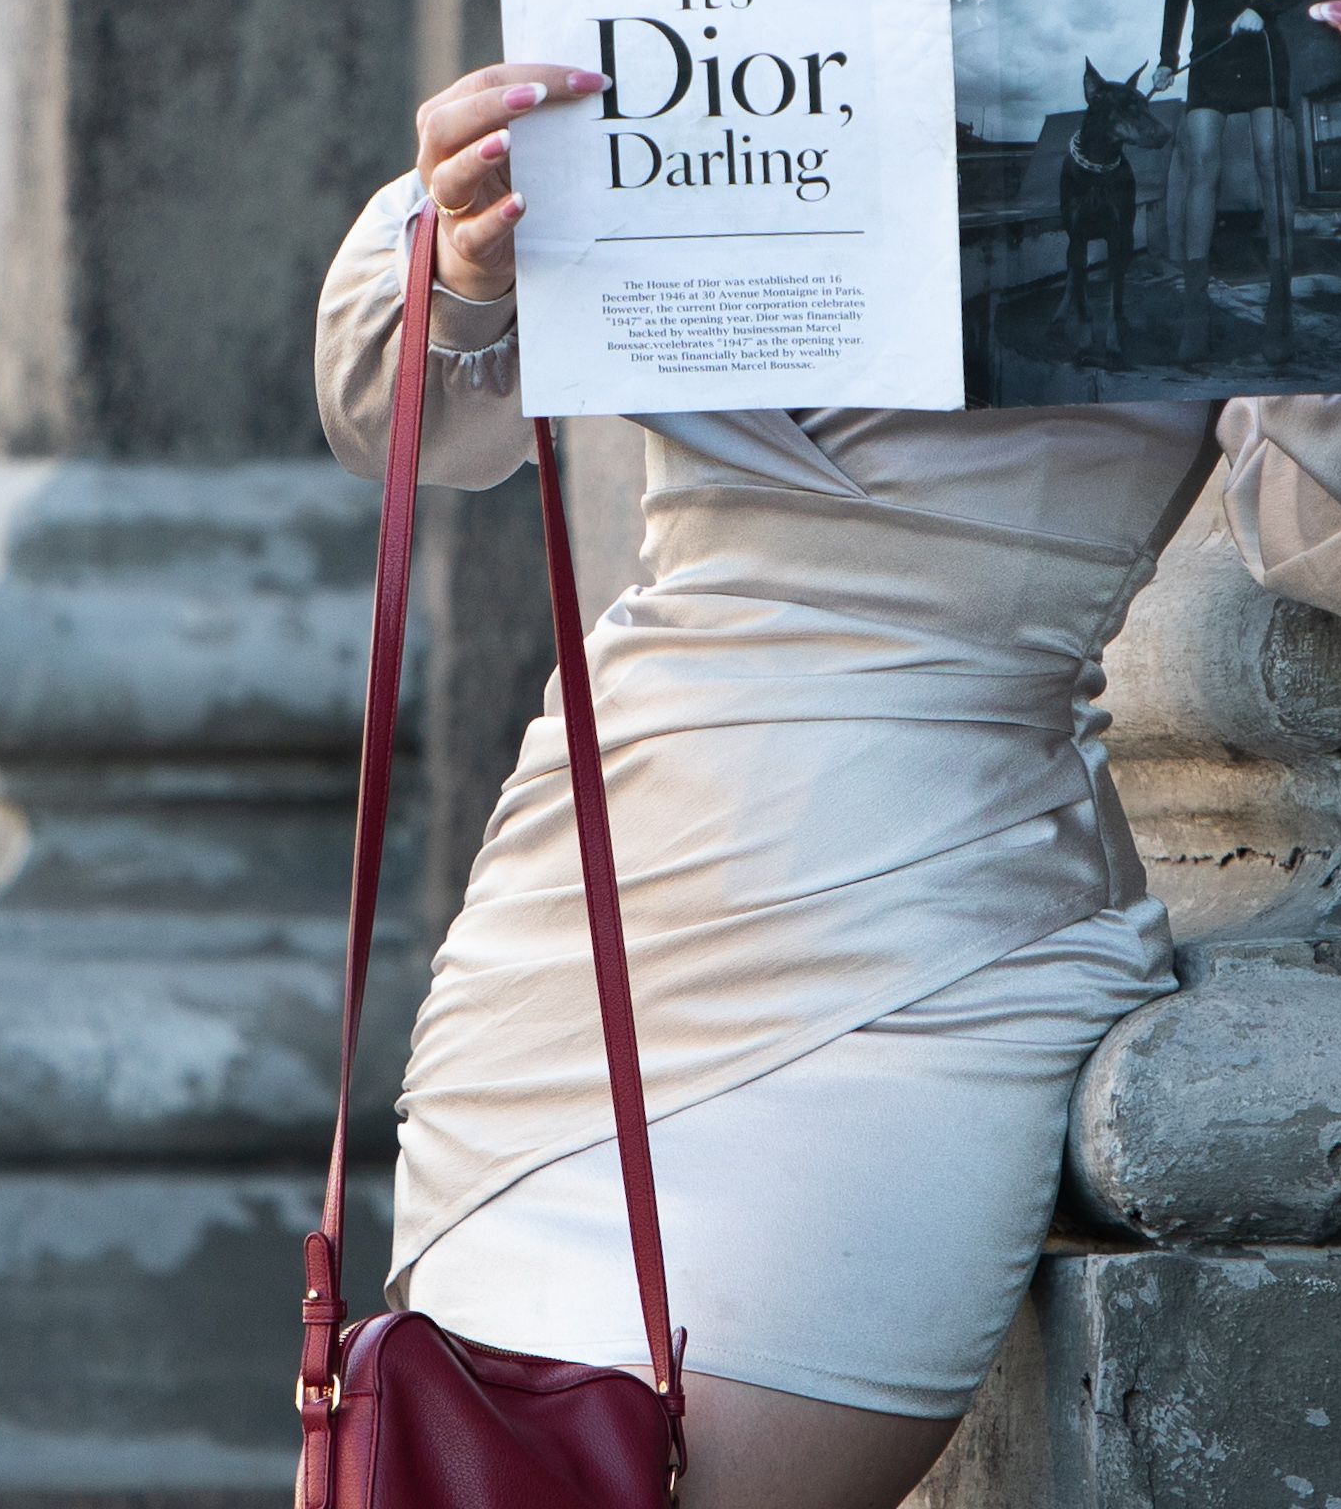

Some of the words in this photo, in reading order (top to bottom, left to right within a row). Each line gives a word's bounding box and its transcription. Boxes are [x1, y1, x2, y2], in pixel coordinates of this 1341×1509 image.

[586, 17, 853, 128] Dior,
[603, 129, 831, 202] Darling
[623, 280, 644, 290] The
[647, 280, 680, 289] House
[683, 279, 694, 288] of
[698, 278, 721, 288] Dior
[724, 279, 745, 287] was
[748, 275, 808, 286] established
[830, 275, 842, 284] 16
[602, 293, 656, 303] December
[660, 291, 686, 301] 1946
[688, 291, 698, 300] at
[702, 290, 715, 300] 30
[718, 291, 760, 299] Avenue
[763, 287, 818, 298] Montaigne
[822, 286, 832, 296] in
[836, 286, 864, 296] Paris.
[603, 305, 653, 315] However,
[656, 303, 673, 313] the
[677, 303, 716, 314] current
[719, 301, 743, 311] Dior
[746, 300, 808, 311] corporation
[811, 298, 865, 308] celebrates
[645, 318, 657, 326] as
[660, 315, 677, 326] the
[680, 315, 724, 326] opening
[756, 312, 780, 322] Dior
[783, 313, 803, 321] was
[807, 310, 863, 321] financially
[629, 327, 667, 338] backed
[668, 327, 684, 339] by
[687, 326, 730, 337] wealthy
[733, 325, 802, 335] businessman
[806, 323, 841, 333] Marcel
[756, 338, 768, 346] as
[771, 336, 788, 346] the
[791, 336, 834, 347] opening
[631, 352, 654, 362] Dior
[682, 350, 738, 361] financially
[741, 348, 779, 359] backed
[782, 348, 796, 359] by
[799, 345, 841, 358] wealthy
[658, 363, 728, 373] businessman
[731, 361, 766, 372] Marcel
